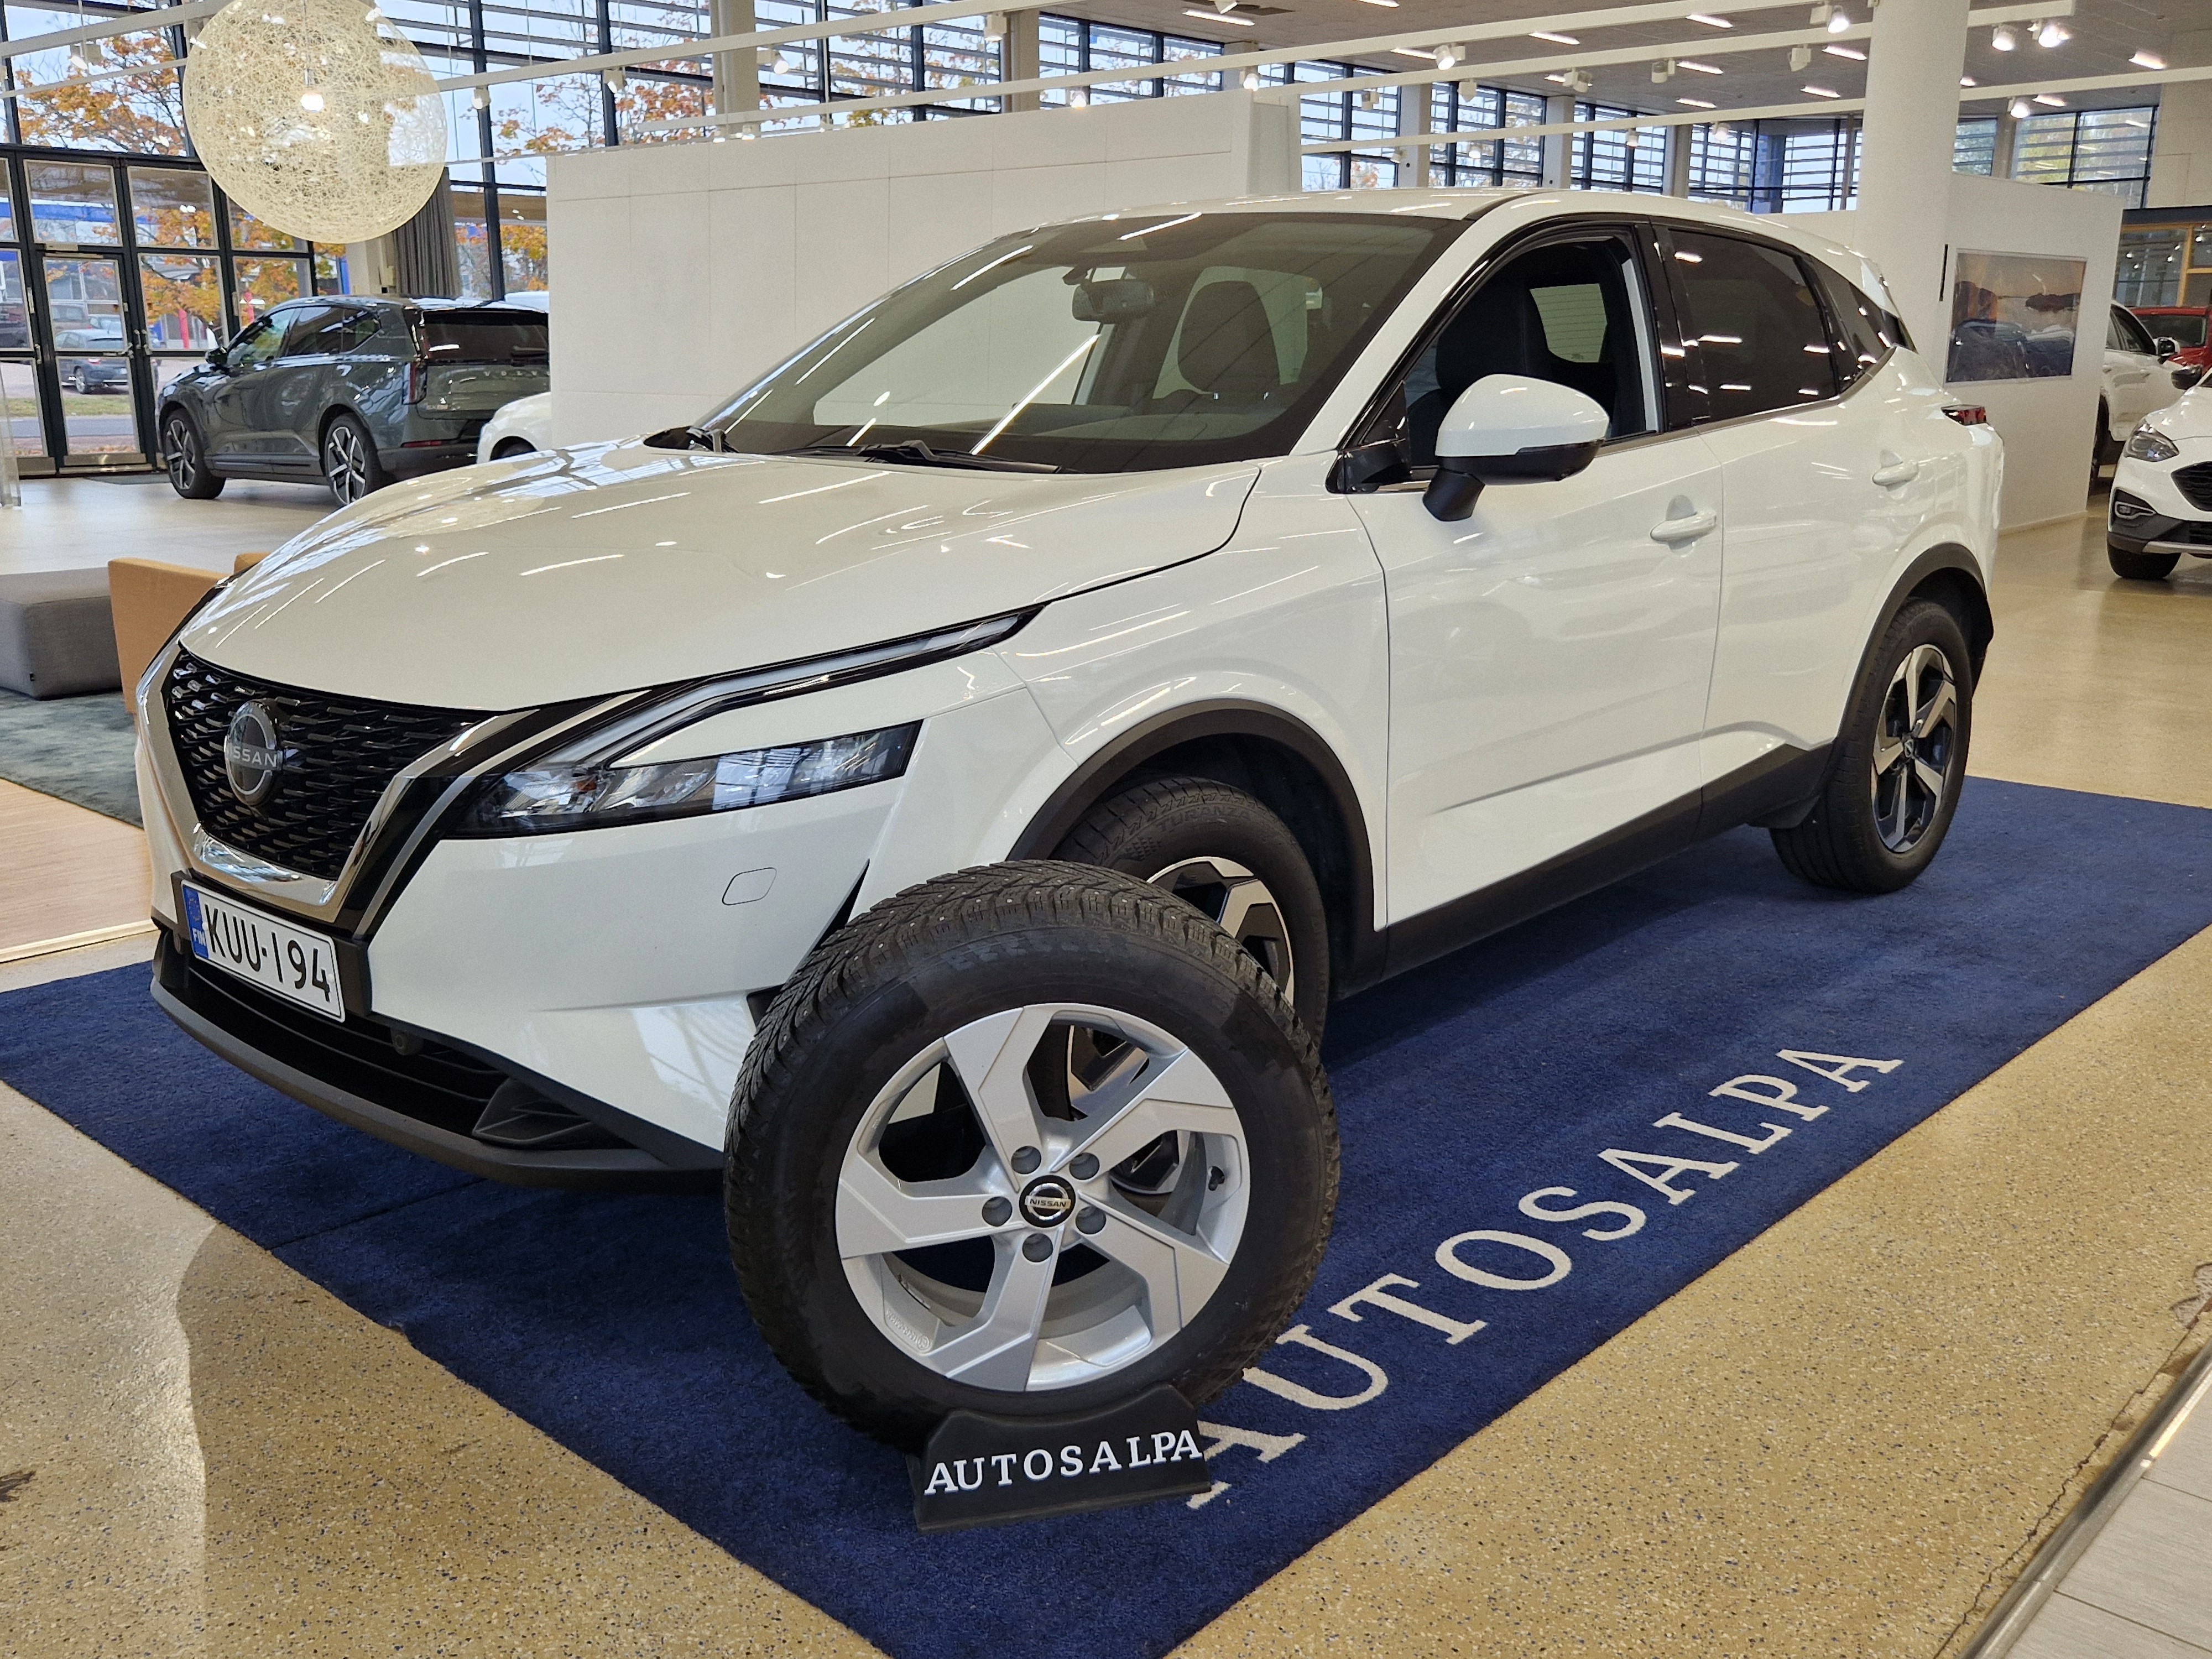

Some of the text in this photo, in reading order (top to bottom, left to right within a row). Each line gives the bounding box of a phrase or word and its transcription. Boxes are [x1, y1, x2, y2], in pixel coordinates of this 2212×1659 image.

[1156, 806, 1250, 832] TURANZA
[192, 927, 206, 946] FIN
[205, 904, 330, 1002] KUU-194
[1030, 1198, 1067, 1207] NISSAN
[924, 1430, 1203, 1496] AUTOSALPA
